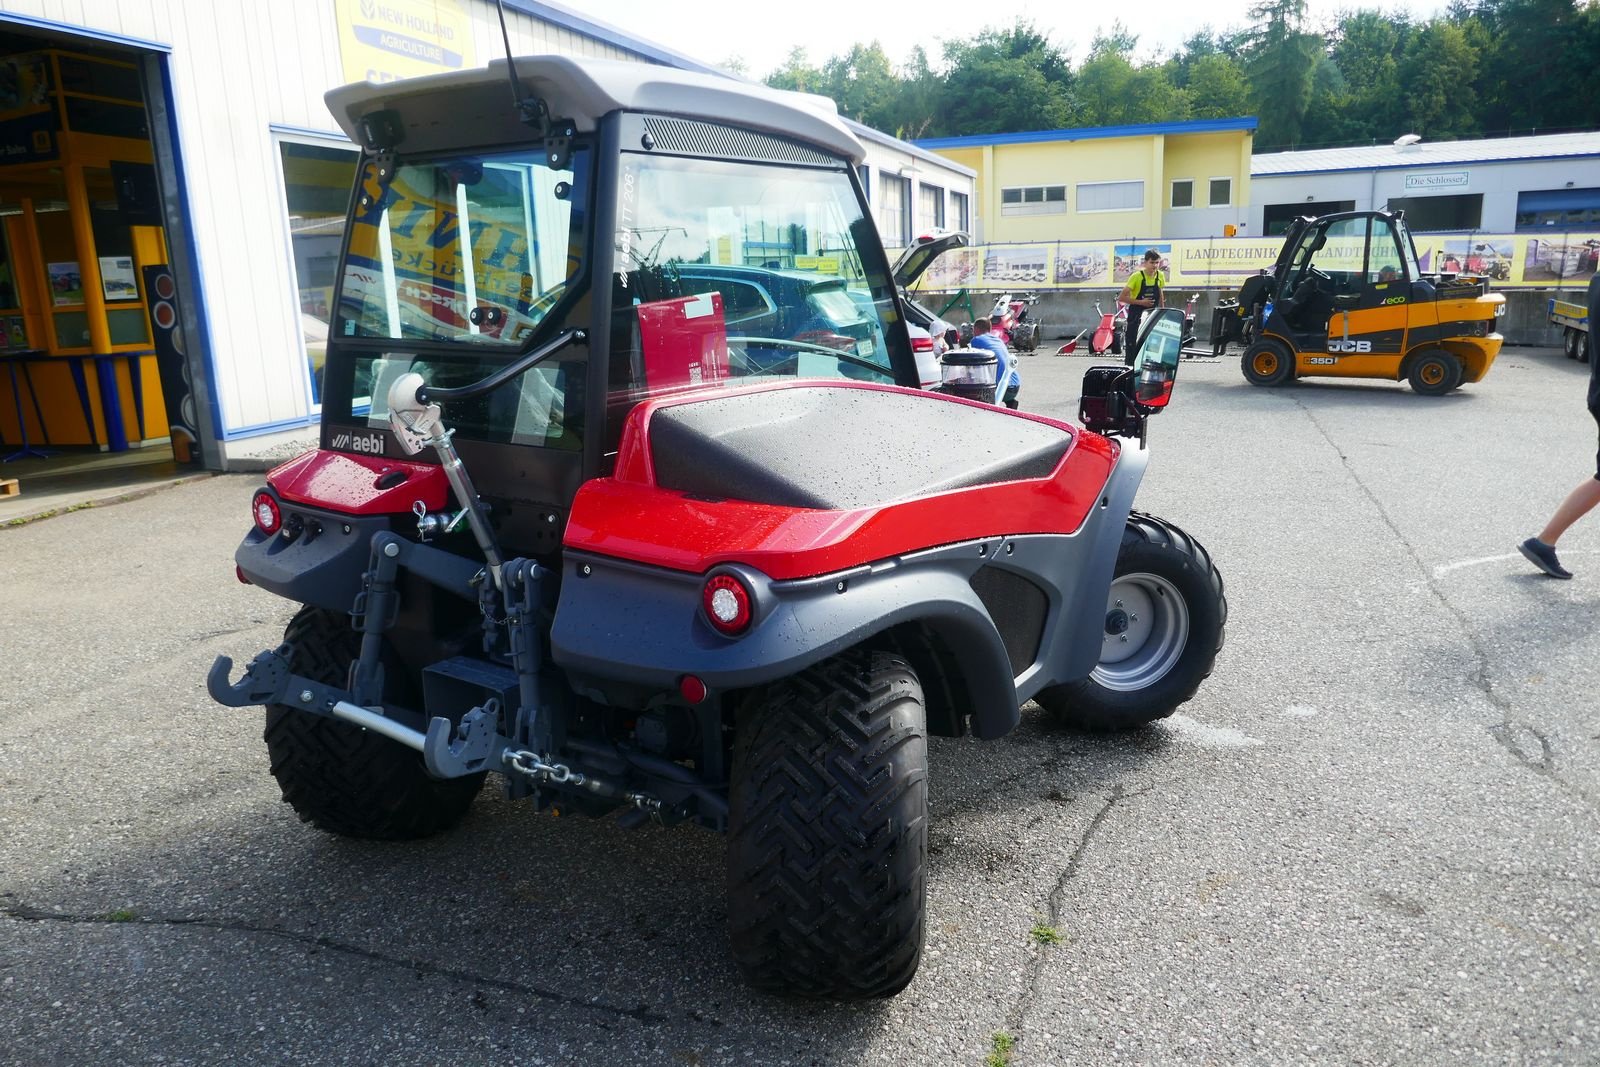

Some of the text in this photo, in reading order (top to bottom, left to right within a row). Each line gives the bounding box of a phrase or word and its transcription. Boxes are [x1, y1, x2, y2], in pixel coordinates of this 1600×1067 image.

[378, 5, 454, 41] NEW HOLLAND
[380, 33, 441, 60] AGRICULTURE
[1410, 177, 1424, 185] Die
[620, 226, 631, 264] aebi
[1186, 247, 1278, 260] LANDTECHNIK
[1316, 246, 1399, 258] LANDTCHN
[1386, 296, 1405, 305] eco
[1327, 340, 1372, 353] JCB
[352, 433, 384, 454] aebi
